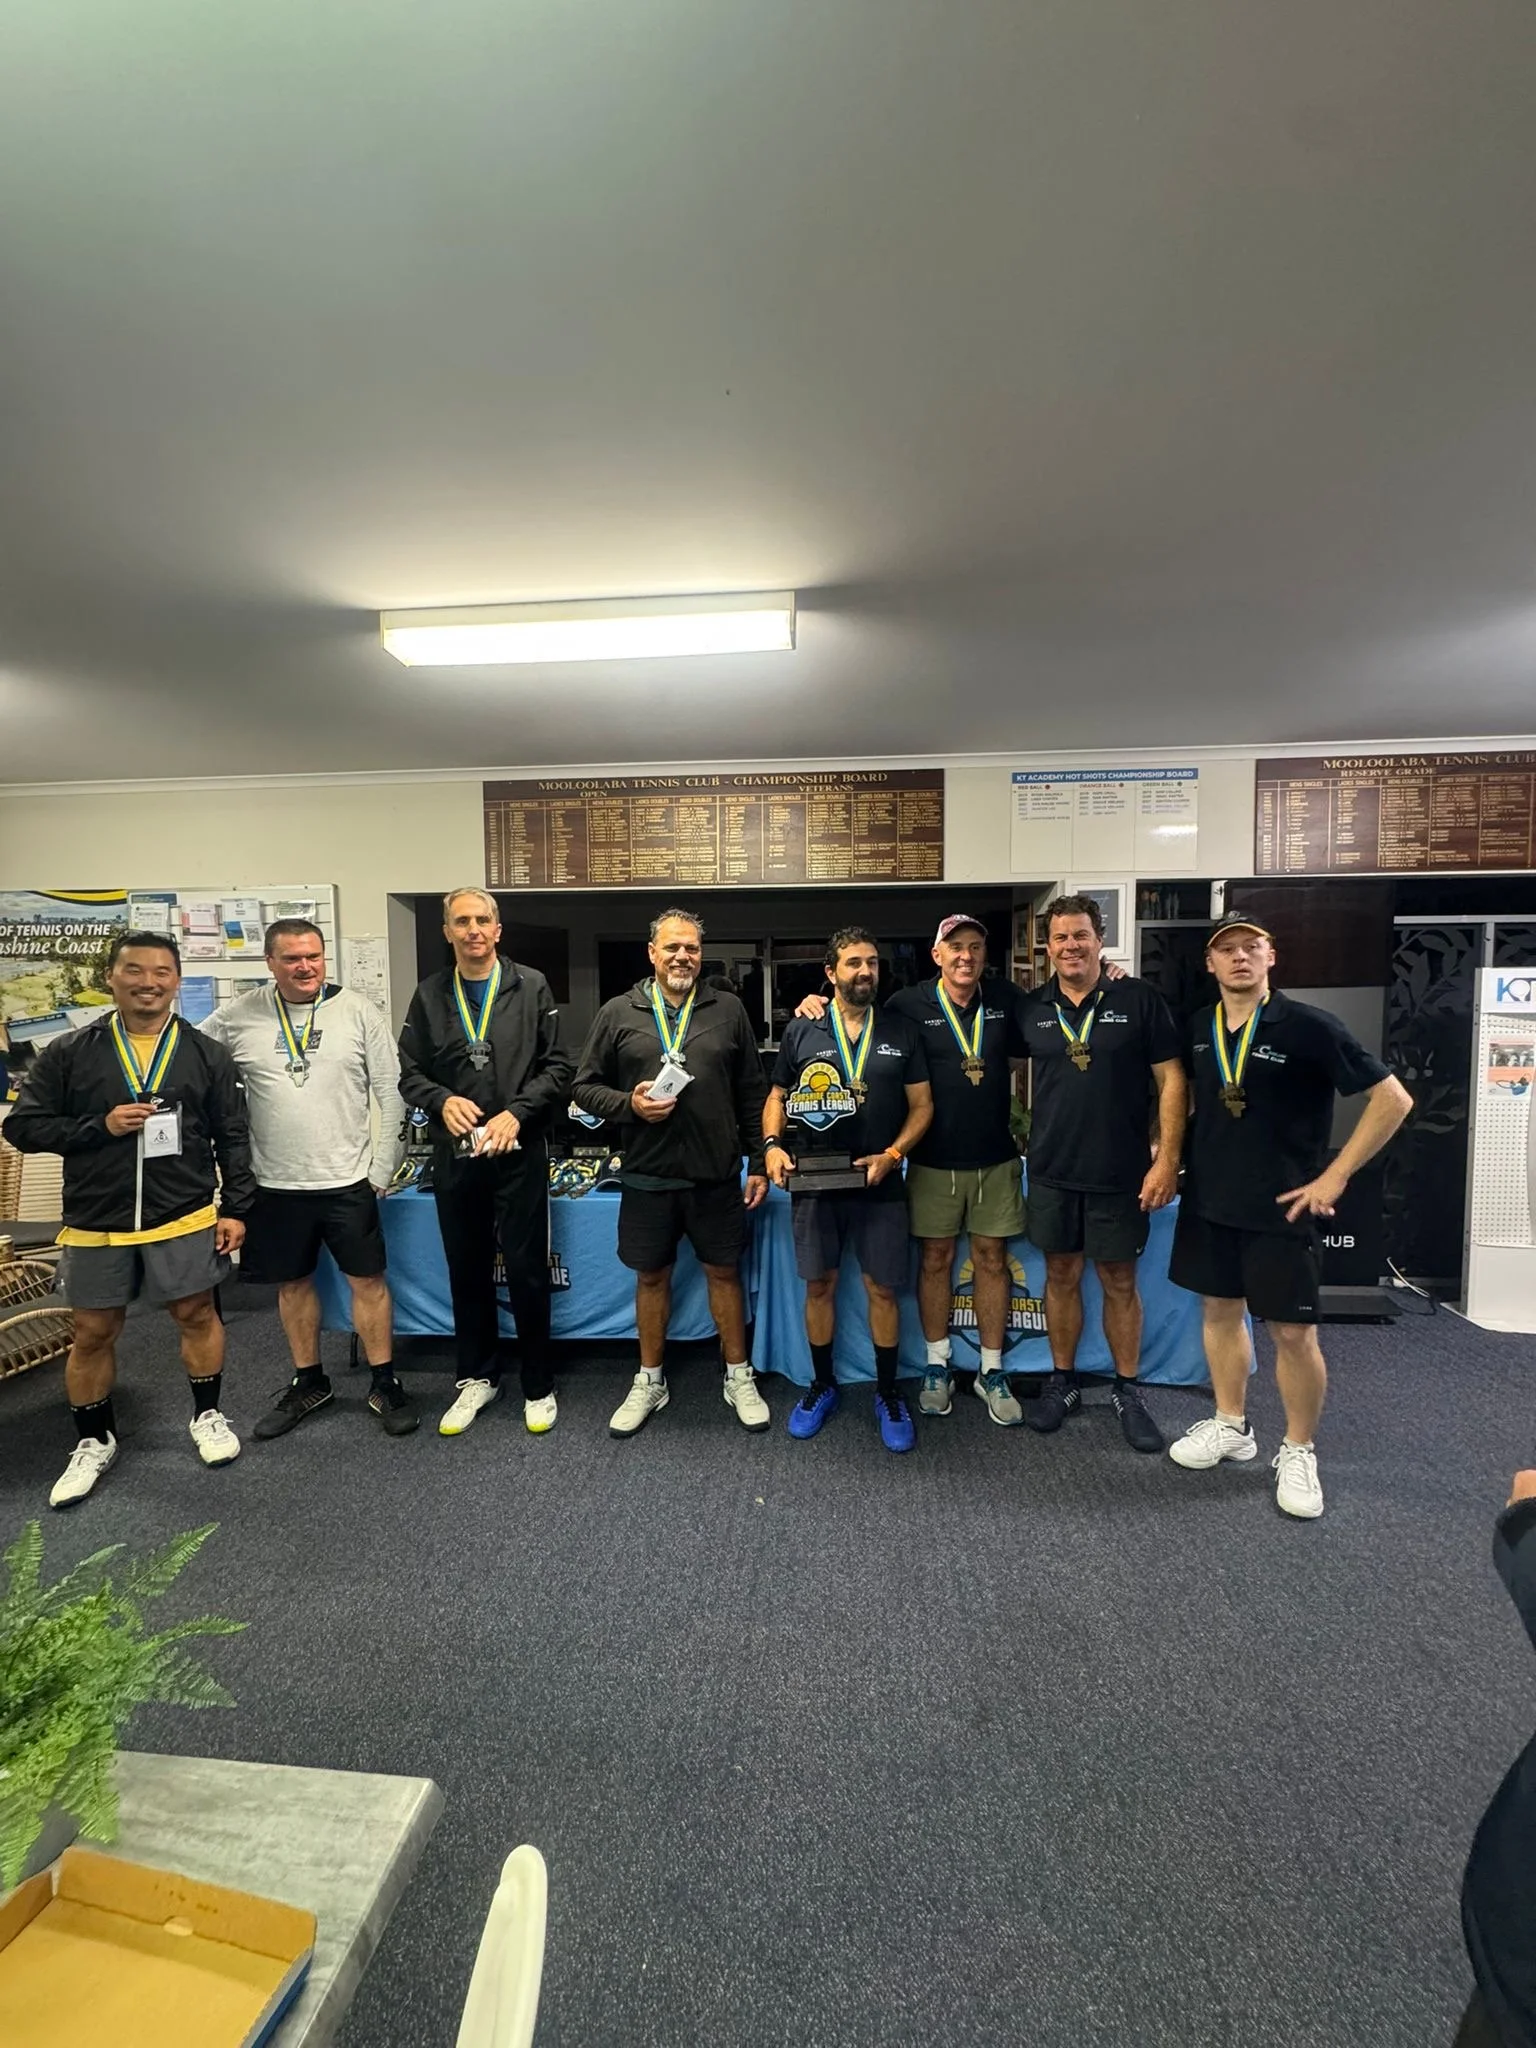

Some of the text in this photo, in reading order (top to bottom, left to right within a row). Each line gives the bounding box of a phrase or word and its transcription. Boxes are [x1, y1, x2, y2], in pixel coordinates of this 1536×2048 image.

[1322, 752, 1535, 770] MOOLOOLABA TENNIS CLUB
[1016, 774, 1027, 782] KT
[1028, 773, 1064, 781] ACADEMY
[1082, 772, 1107, 780] SHOTS
[1108, 771, 1166, 780] CHAMPIONSHIP
[1166, 770, 1194, 778] BOARD
[1340, 767, 1436, 777] RESERVE GRADE
[538, 779, 627, 791] MOOLOOLABA
[632, 778, 680, 789] TENNIS
[685, 776, 720, 787] CLUB
[733, 774, 837, 786] CHAMPIONSHIP
[842, 772, 888, 784] BOARD
[579, 790, 608, 799] OPEN
[798, 784, 854, 793] VETERANS
[0, 924, 111, 937] OF TENNIS ON THE
[55, 936, 105, 955] Coast
[791, 1091, 848, 1103] SUNSHINE COAST
[788, 1100, 854, 1113] TENNIS LEAGUE
[1011, 1297, 1042, 1312] OAST
